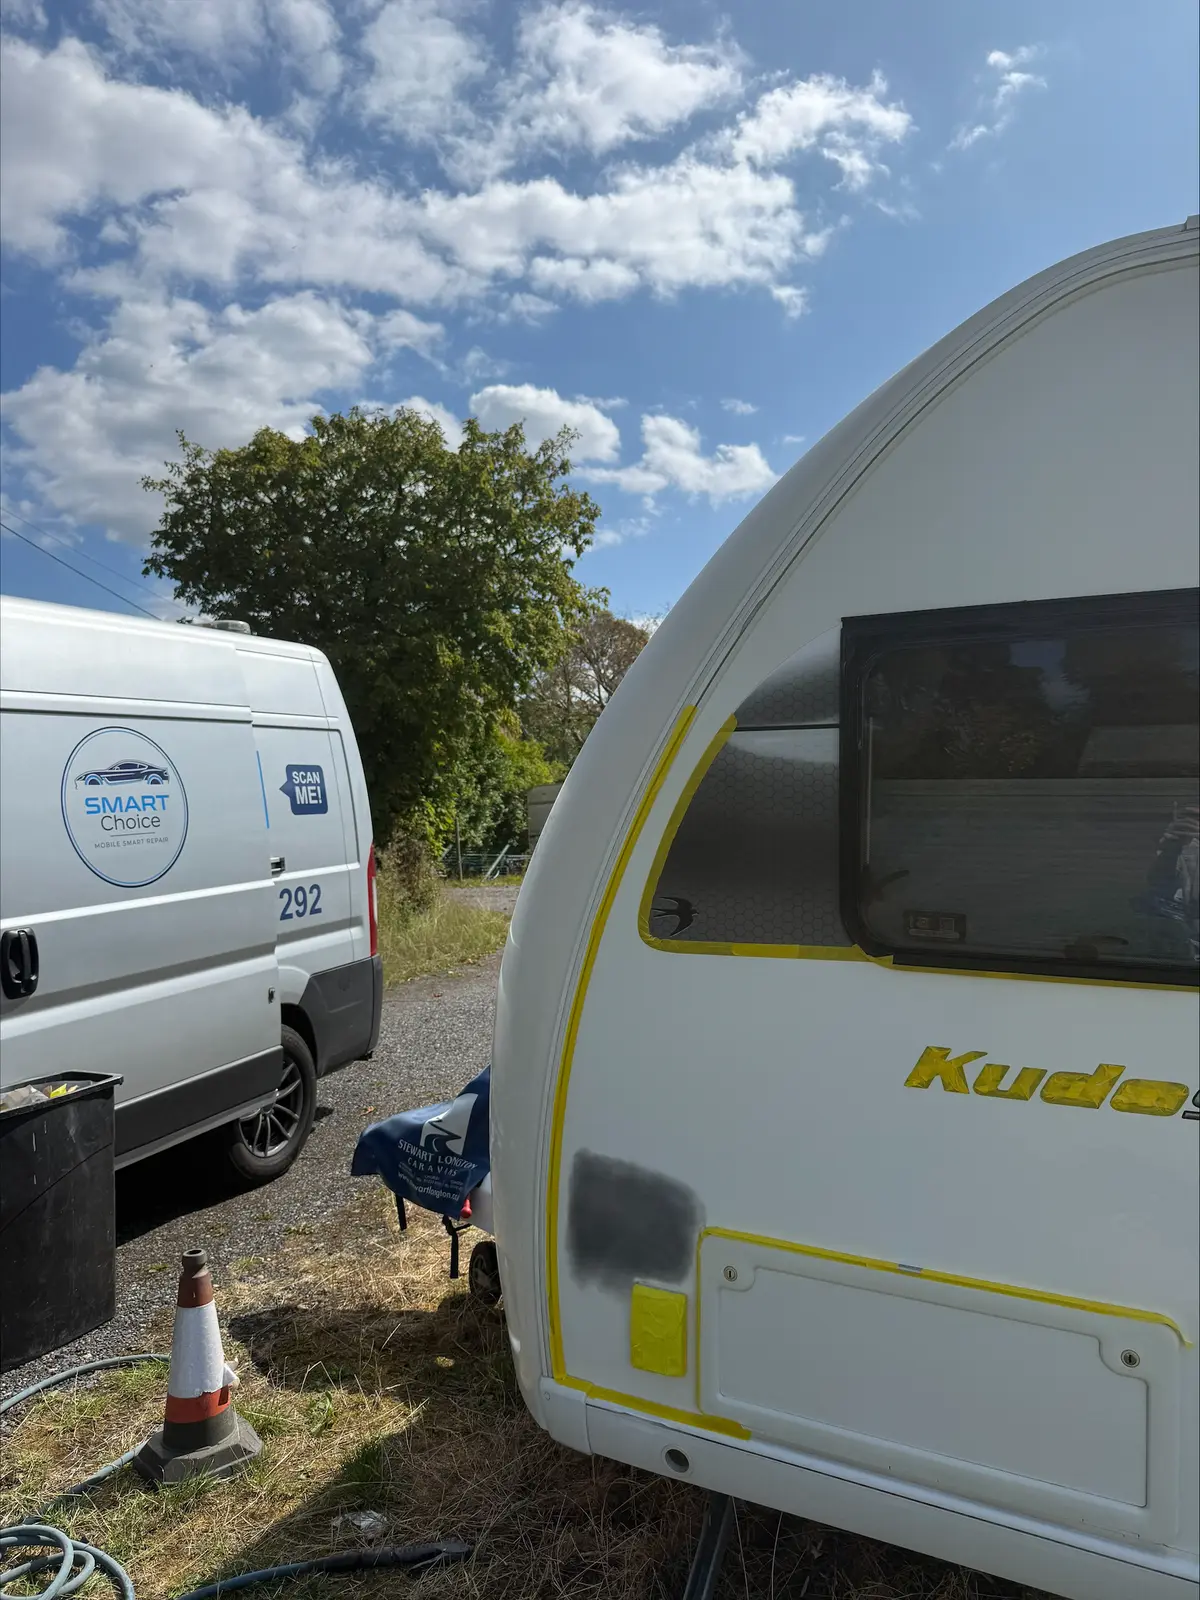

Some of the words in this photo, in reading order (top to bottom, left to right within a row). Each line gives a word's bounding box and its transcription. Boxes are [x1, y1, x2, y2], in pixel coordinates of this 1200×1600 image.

[291, 770, 321, 785] SCAN
[85, 795, 169, 814] SMART
[294, 785, 323, 806] ME!
[100, 813, 161, 832] Choice
[94, 839, 121, 849] MOBILE
[122, 838, 145, 847] SMART
[146, 836, 169, 844] REPAIR
[278, 883, 323, 921] 292
[903, 1045, 1199, 1120] Kudo
[398, 1139, 434, 1162] STEWART
